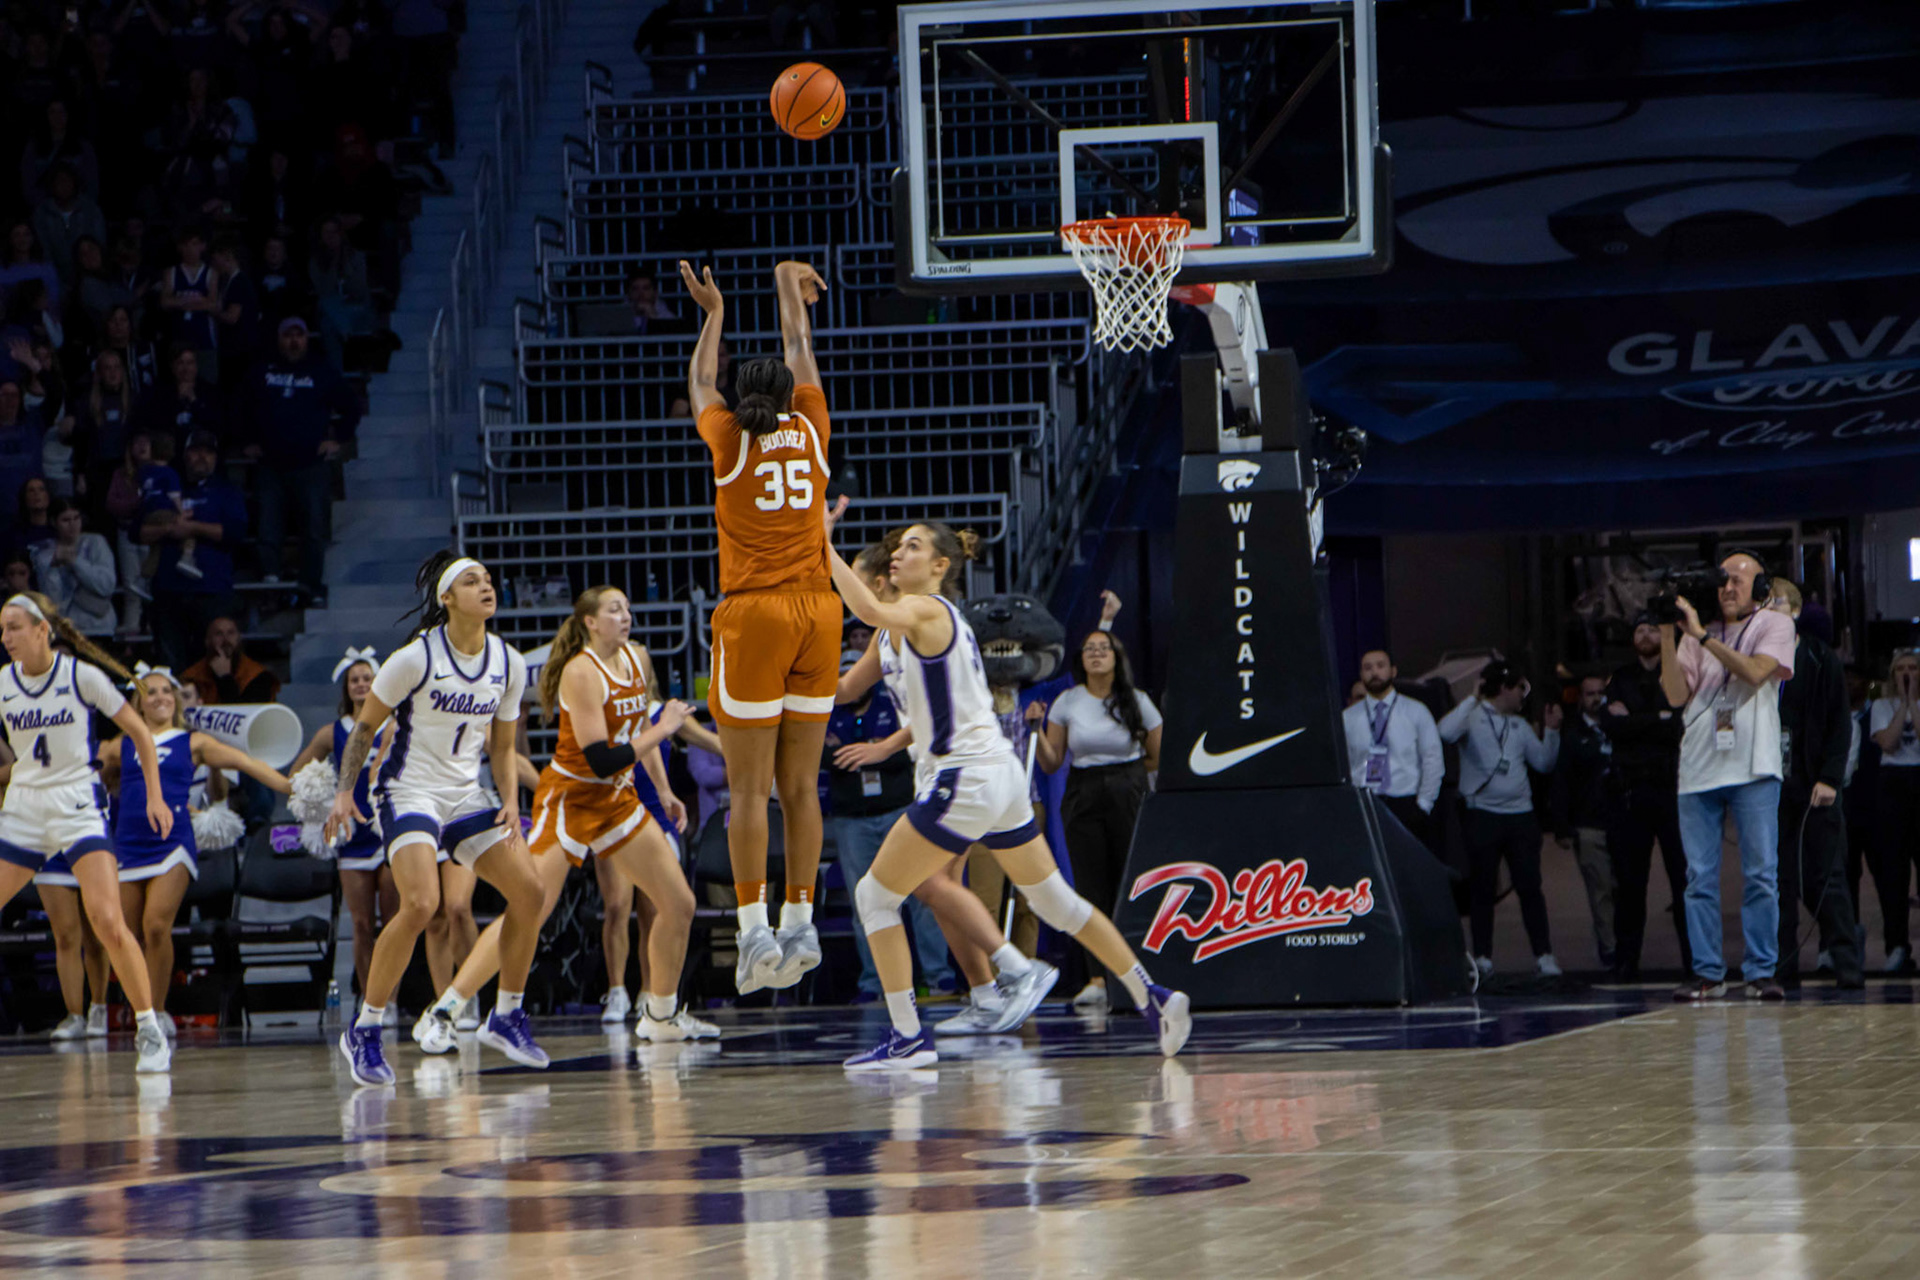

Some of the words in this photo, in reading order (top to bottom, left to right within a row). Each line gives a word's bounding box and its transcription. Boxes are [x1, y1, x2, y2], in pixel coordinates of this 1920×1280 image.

[757, 429, 806, 455] BOOKER
[754, 459, 814, 512] 35
[1228, 502, 1255, 720] WILDCATS
[6, 708, 76, 731] Wildcats
[33, 734, 51, 767] 4
[452, 722, 468, 756] 1
[1128, 857, 1374, 956] Dillons
[1285, 934, 1317, 948] FOOD
